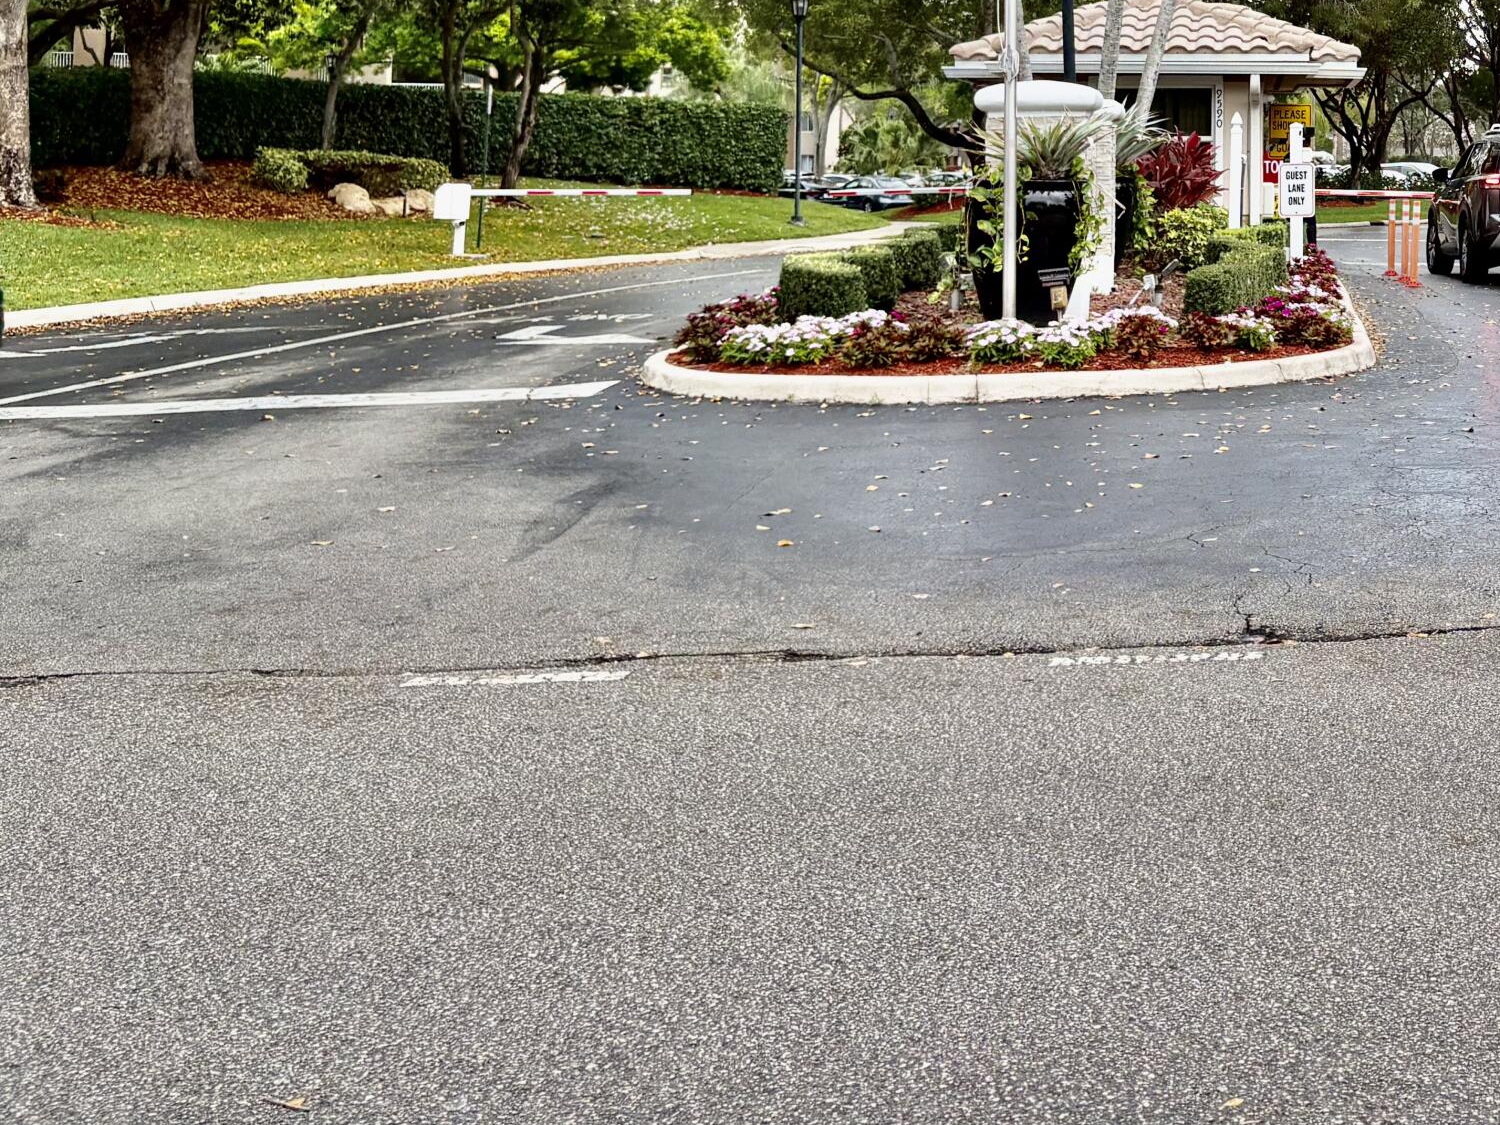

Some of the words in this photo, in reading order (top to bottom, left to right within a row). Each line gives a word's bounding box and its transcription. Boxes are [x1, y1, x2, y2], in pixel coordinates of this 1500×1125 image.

[1273, 110, 1307, 120] PLEASE
[1285, 171, 1308, 180] GUEST
[1288, 184, 1305, 193] LANE
[1288, 196, 1305, 206] ONLY
